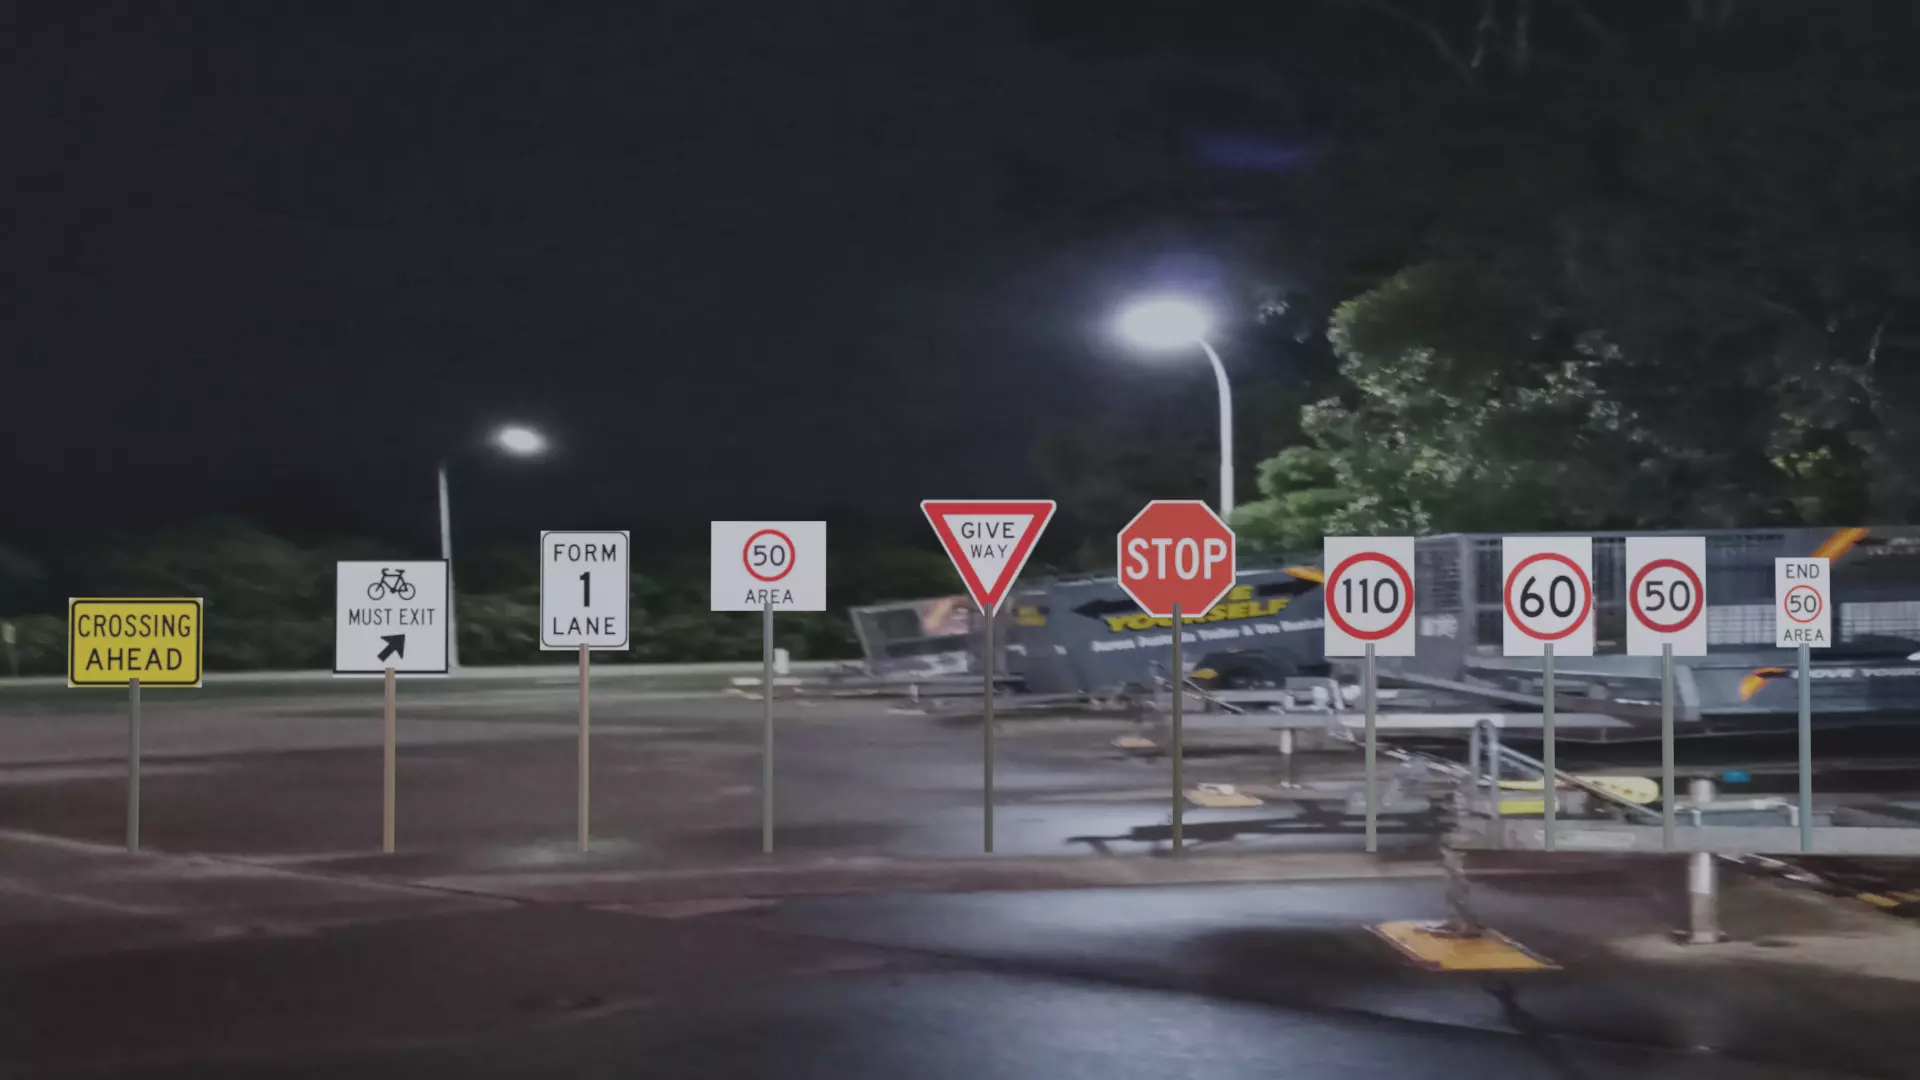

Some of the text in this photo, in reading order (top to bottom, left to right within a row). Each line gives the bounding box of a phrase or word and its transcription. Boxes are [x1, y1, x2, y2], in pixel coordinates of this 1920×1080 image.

[961, 521, 1015, 539] GIVE
[553, 544, 617, 562] FORM
[753, 544, 786, 567] 50
[970, 545, 1008, 559] WAY
[1125, 537, 1229, 580] STOP
[1785, 564, 1820, 579] END
[579, 571, 591, 608] 1
[745, 588, 794, 604] AREA
[1342, 577, 1400, 614] 110
[1519, 574, 1577, 618] 60
[1645, 579, 1691, 613] 50
[1790, 594, 1817, 613] 50
[77, 614, 192, 638] CROSSING
[348, 608, 436, 626] MUST EXIT
[552, 616, 616, 636] LANE
[1783, 628, 1825, 642] AREA
[85, 647, 183, 671] AHEAD
